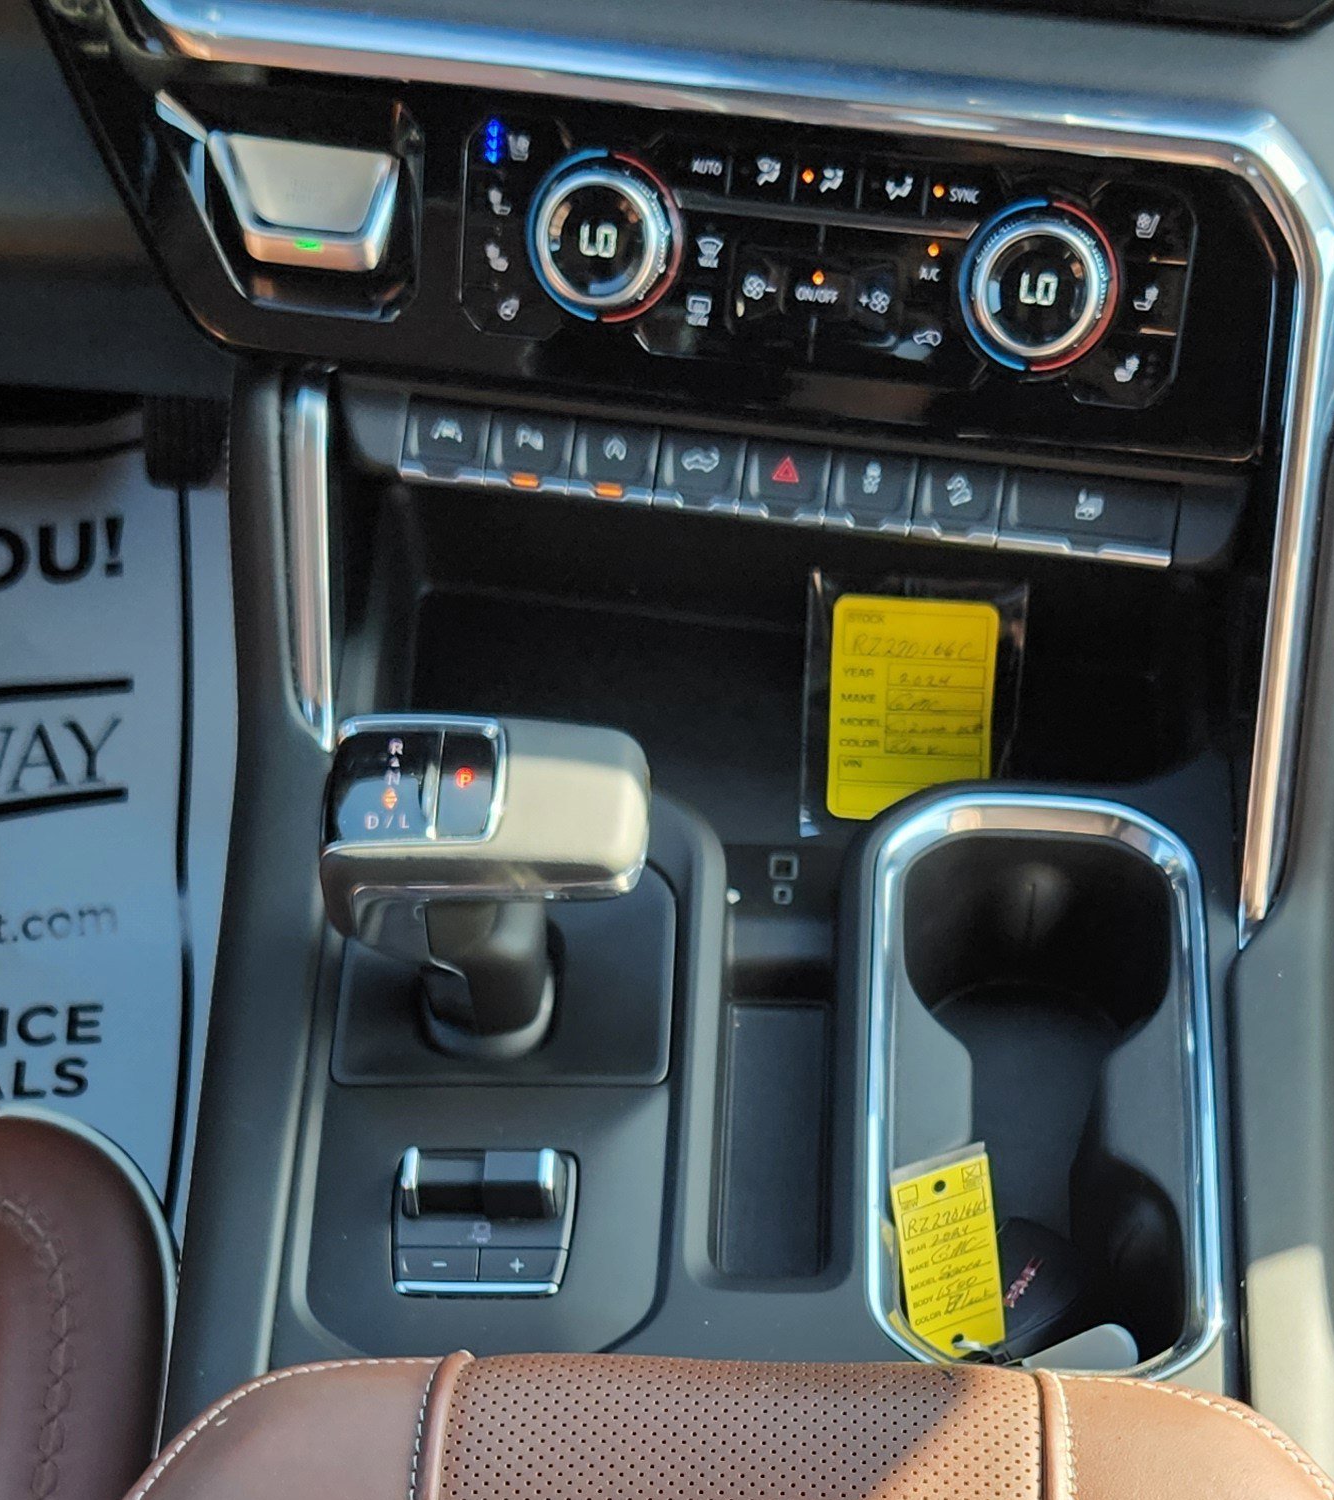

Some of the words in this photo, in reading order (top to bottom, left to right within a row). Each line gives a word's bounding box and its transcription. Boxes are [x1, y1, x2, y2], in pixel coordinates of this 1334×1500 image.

[691, 159, 722, 176] AUTO
[949, 187, 980, 204] SYNC
[919, 267, 941, 282] A/C
[848, 613, 885, 624] STOCK
[843, 667, 875, 678] YEAR
[841, 693, 876, 704] MAKE
[843, 759, 863, 769] VIN
[906, 1243, 927, 1255] YEAR
[908, 1260, 930, 1274] MAKE
[911, 1277, 937, 1291] MODEL
[913, 1295, 934, 1310] BODY
[914, 1310, 942, 1326] COLOR
